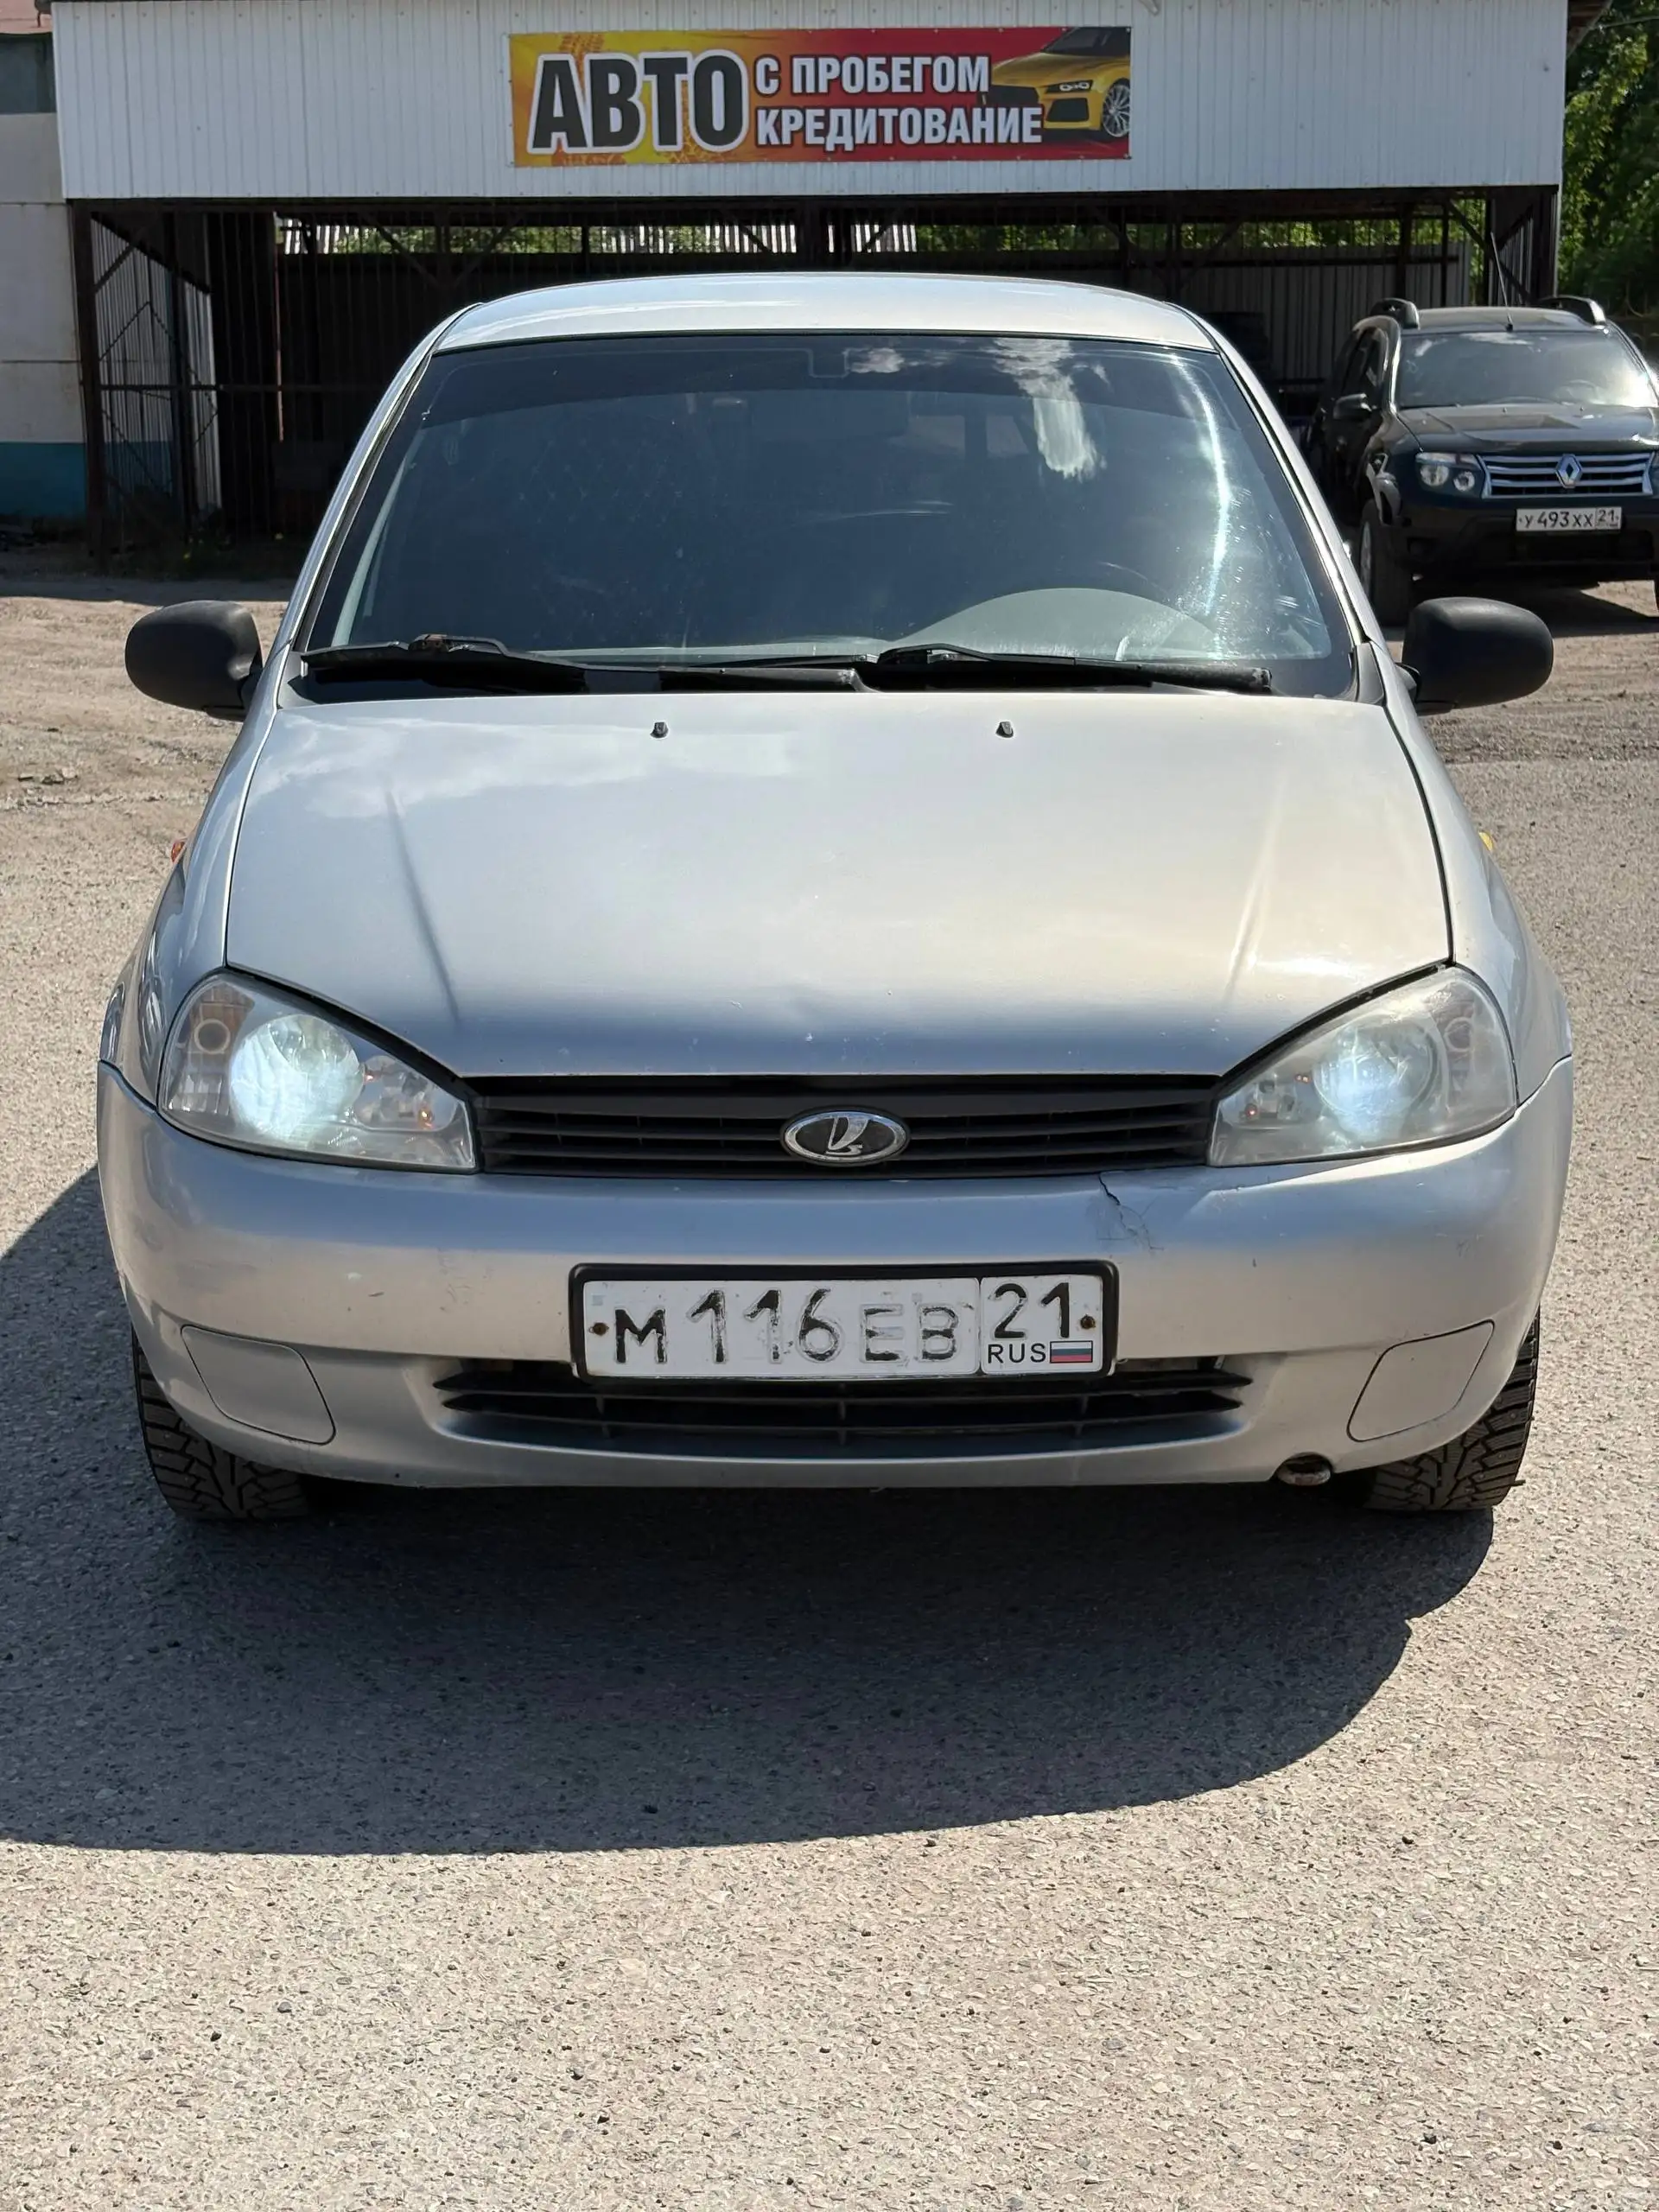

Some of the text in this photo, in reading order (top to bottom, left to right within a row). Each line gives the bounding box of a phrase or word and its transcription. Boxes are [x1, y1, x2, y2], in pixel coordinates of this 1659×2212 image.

[755, 55, 990, 94] С ПРОБЕГОМ
[527, 51, 748, 153] АВТО
[756, 106, 1042, 152] КРЕДИТОВАНИЕ
[1599, 509, 1615, 522] 21
[990, 1282, 1070, 1338] 21
[988, 1343, 1046, 1363] RUS
